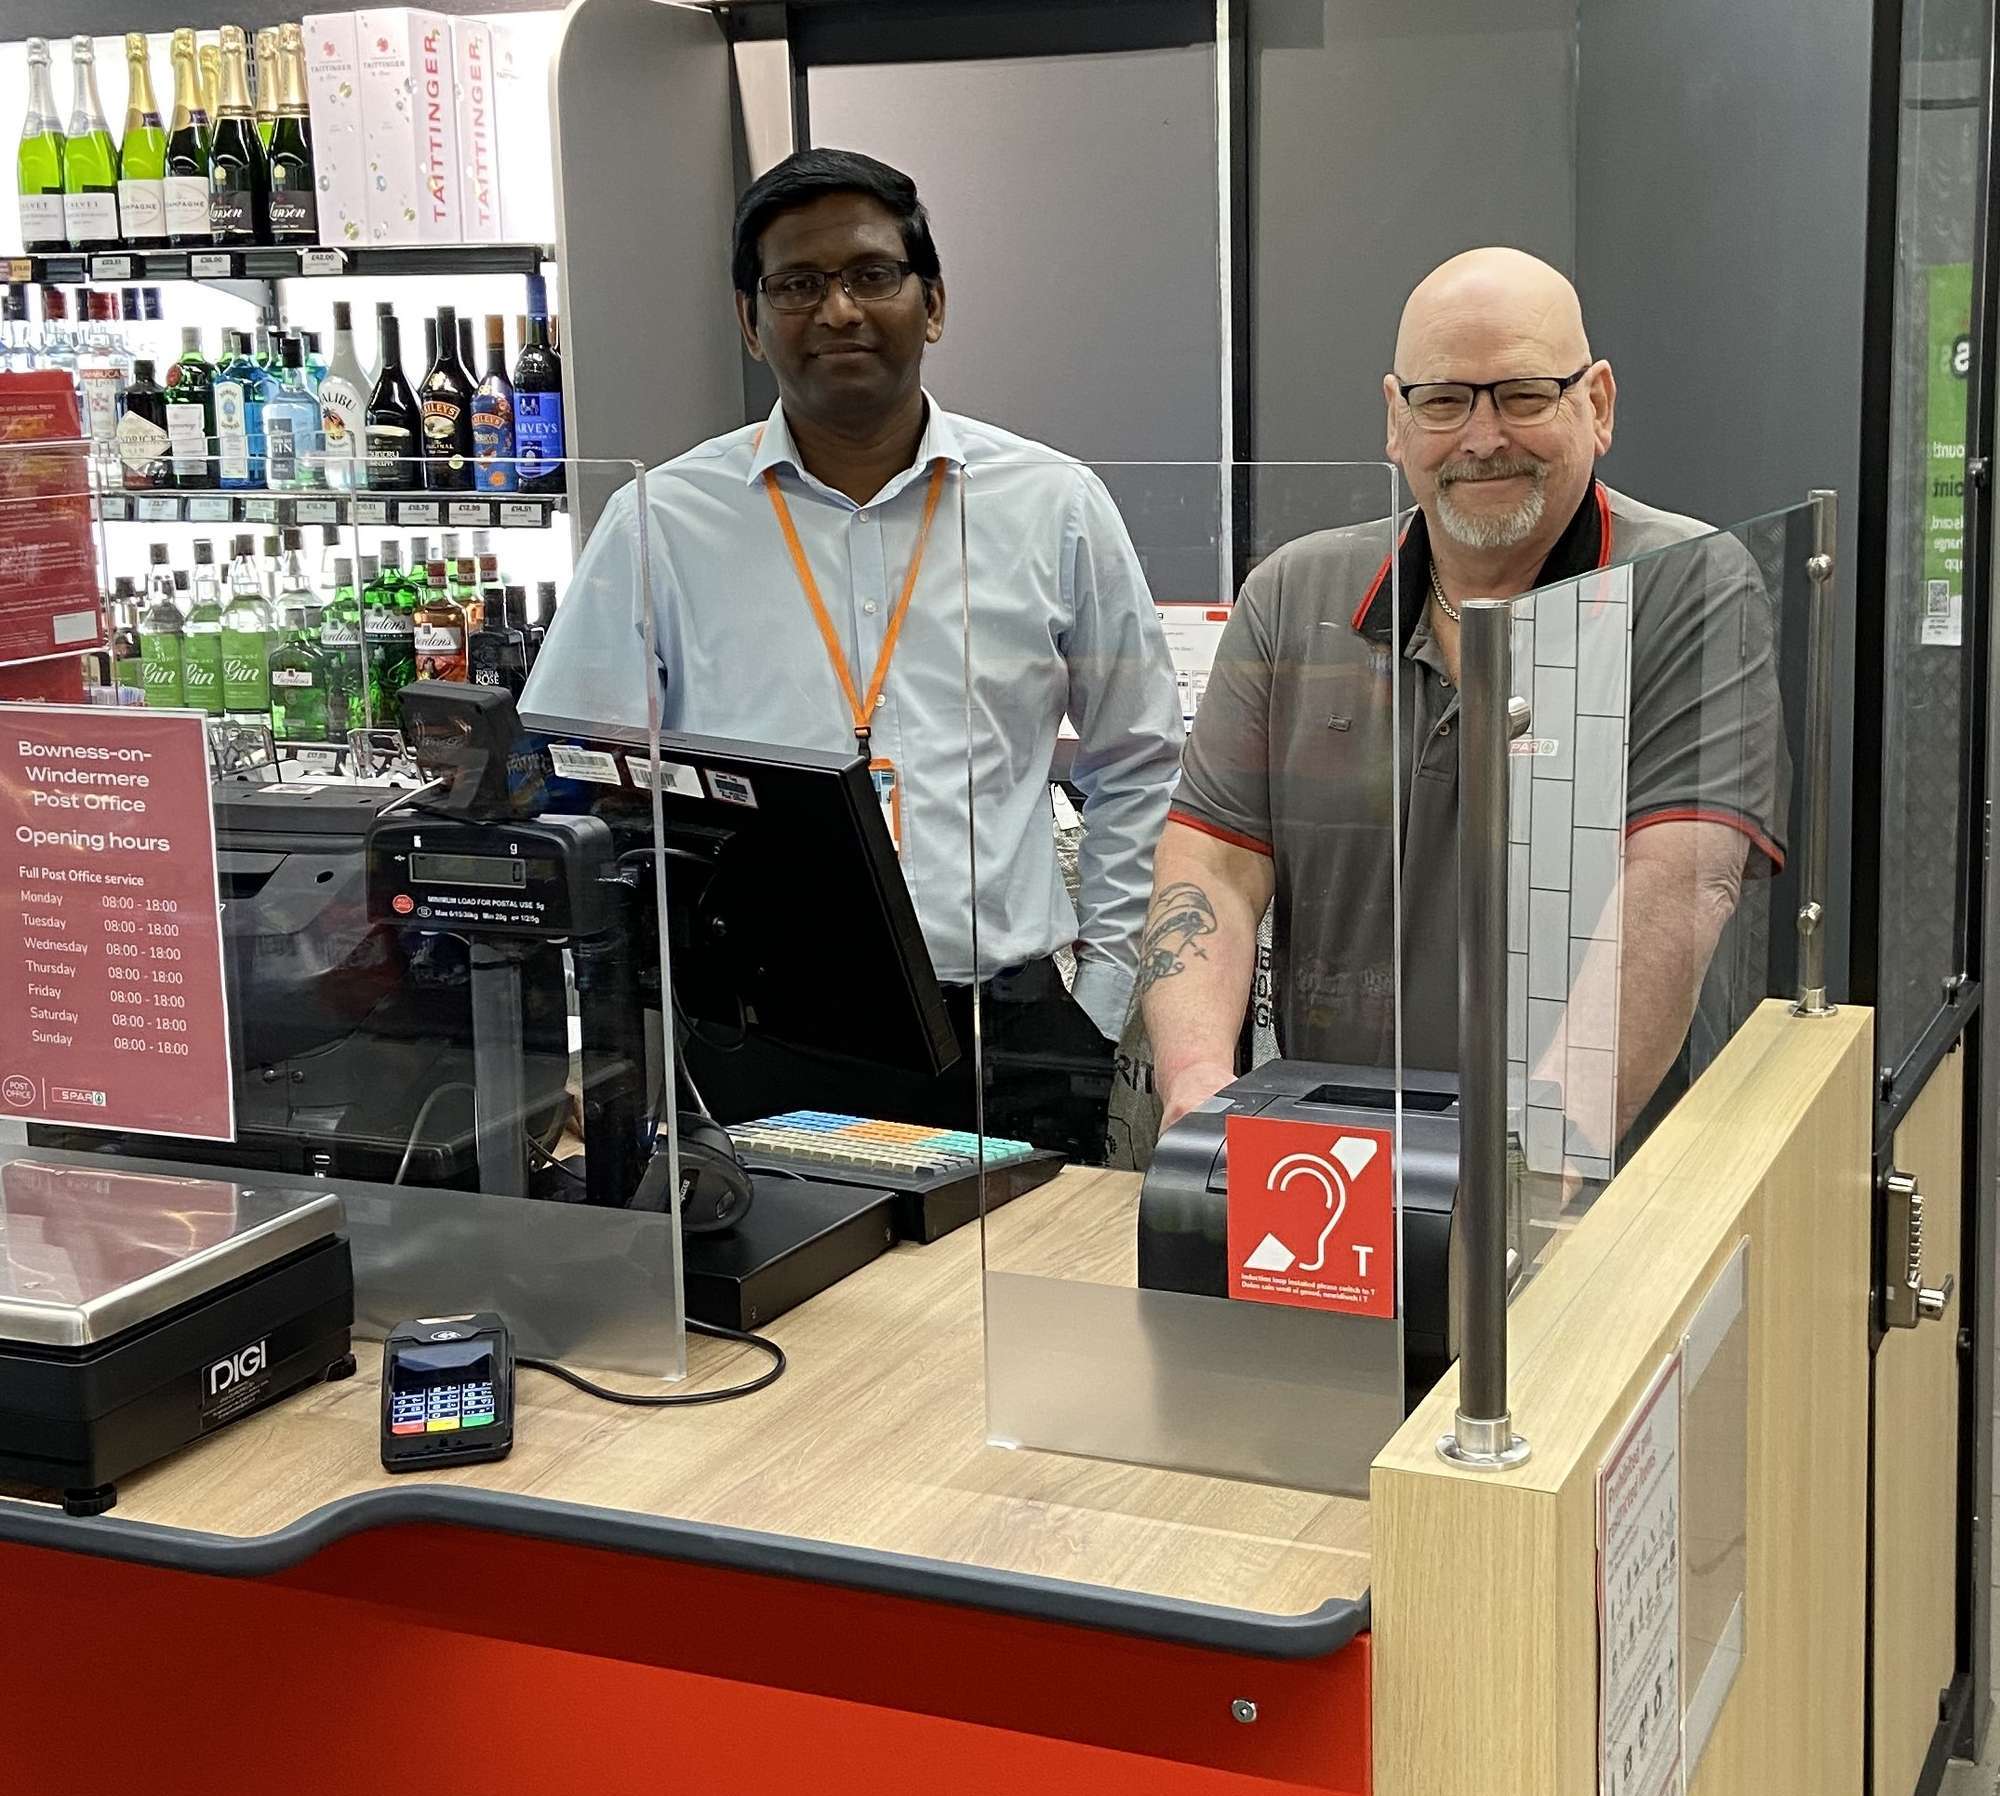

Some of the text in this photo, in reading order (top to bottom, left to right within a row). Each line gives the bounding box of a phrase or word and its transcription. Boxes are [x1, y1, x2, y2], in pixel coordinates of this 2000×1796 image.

[424, 30, 446, 222] TAITTINGER
[469, 40, 490, 226] TAITTINGER
[210, 202, 242, 222] Lanson
[270, 202, 306, 220] Lanson
[321, 392, 356, 410] ALIBU
[424, 404, 456, 416] AILEYS
[518, 424, 558, 434] ARVEYS
[143, 662, 176, 684] Gin
[186, 663, 214, 686] Gin
[224, 660, 260, 682] Gin
[476, 674, 500, 686] ROSE
[18, 740, 152, 762] Bowness-on-
[25, 766, 150, 788] Windermere
[33, 791, 146, 812] Post Office
[16, 826, 170, 852] Opening hours
[510, 844, 518, 854] g
[19, 866, 144, 886] Full Post Office service
[20, 890, 63, 906] Monday
[102, 896, 134, 910] 08:00
[146, 899, 177, 912] 18:00
[458, 898, 476, 906] LOAD
[477, 898, 492, 906] FOR
[492, 900, 518, 908] POSTAL
[536, 902, 544, 910] 5g
[22, 913, 66, 930] Tuesday
[104, 920, 136, 934] 08:00
[148, 923, 179, 936] 18:00
[24, 938, 88, 954] Wednesday
[106, 943, 138, 956] 08:00
[150, 946, 181, 960] 18:00
[26, 960, 76, 978] Thursday
[108, 967, 140, 980] 08:00
[152, 970, 183, 984] 18:00
[28, 984, 62, 999] Friday
[110, 990, 142, 1004] 08:00
[154, 994, 185, 1008] 18:00
[30, 1006, 78, 1024] Saturday
[112, 1014, 144, 1028] 08:00
[156, 1018, 186, 1032] 18:00
[32, 1030, 72, 1046] Sunday
[114, 1037, 146, 1051] 08:00
[158, 1042, 188, 1056] 18:00
[6, 1089, 31, 1100] OFFICE
[10, 1081, 28, 1090] POST
[62, 1090, 92, 1102] SPAR
[1352, 1244, 1374, 1277] T
[1316, 1282, 1338, 1291] please
[1339, 1284, 1360, 1294] switch
[210, 1340, 266, 1396] DIGI
